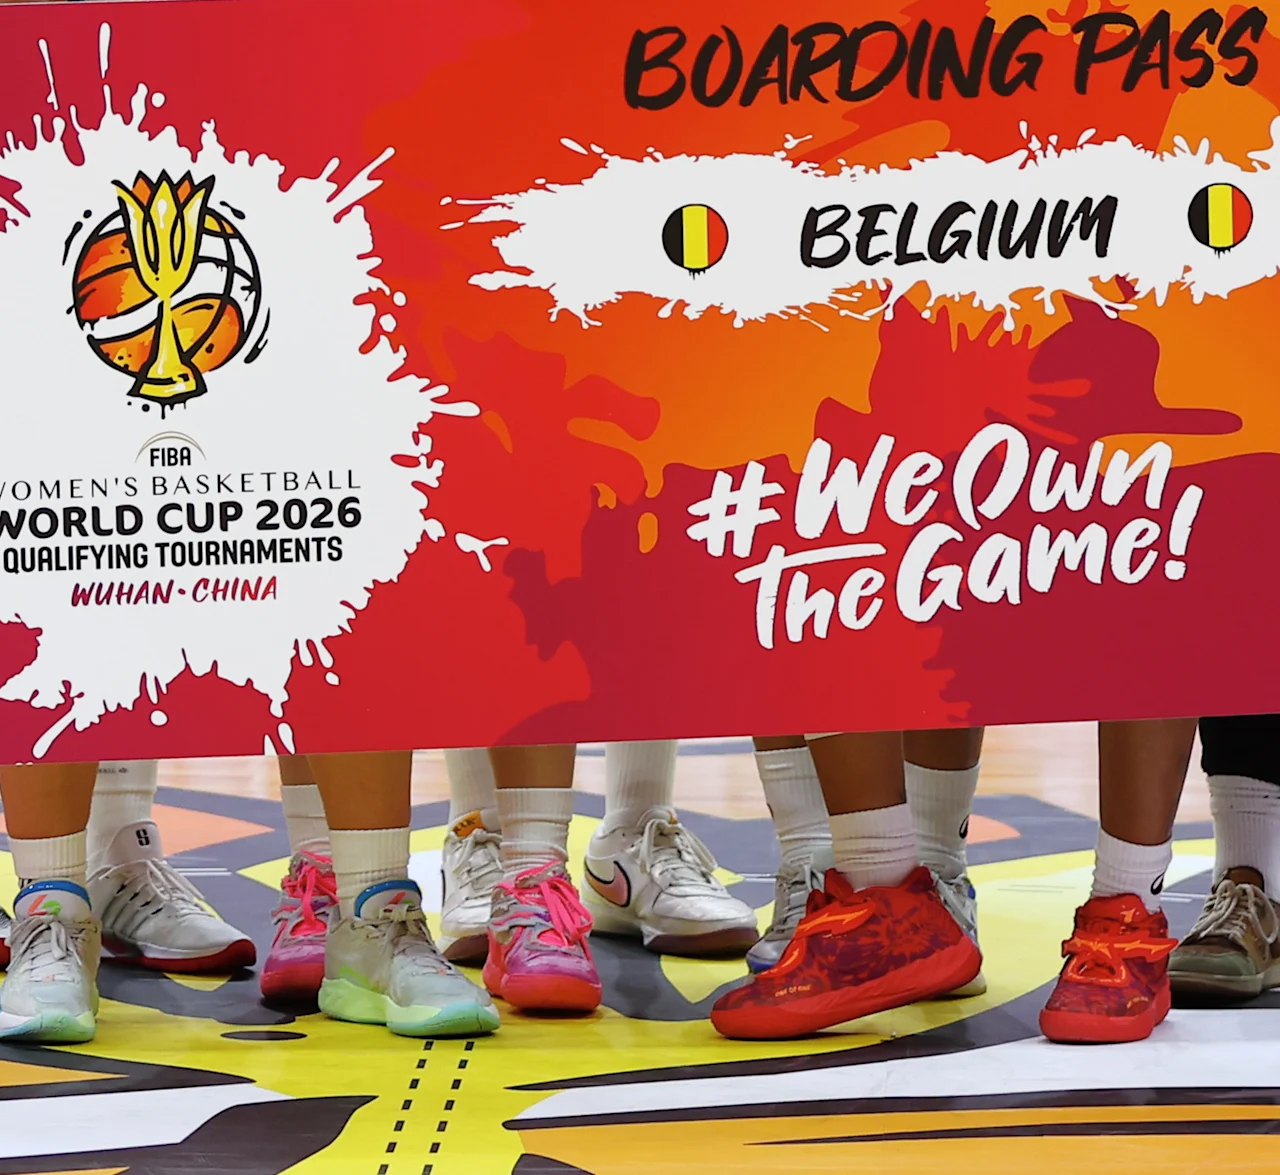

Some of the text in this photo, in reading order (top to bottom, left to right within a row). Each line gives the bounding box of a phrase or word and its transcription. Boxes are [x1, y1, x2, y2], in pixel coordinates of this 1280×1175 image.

[624, 6, 1268, 110] BOARDING PASS
[799, 194, 1120, 269] BELGIUM
[149, 446, 192, 467] FIBA
[151, 469, 363, 496] BASKETBALL
[156, 501, 244, 535] CUP
[255, 496, 363, 532] 2026
[2, 536, 344, 575] QUALIFYING TOURNAMENTS
